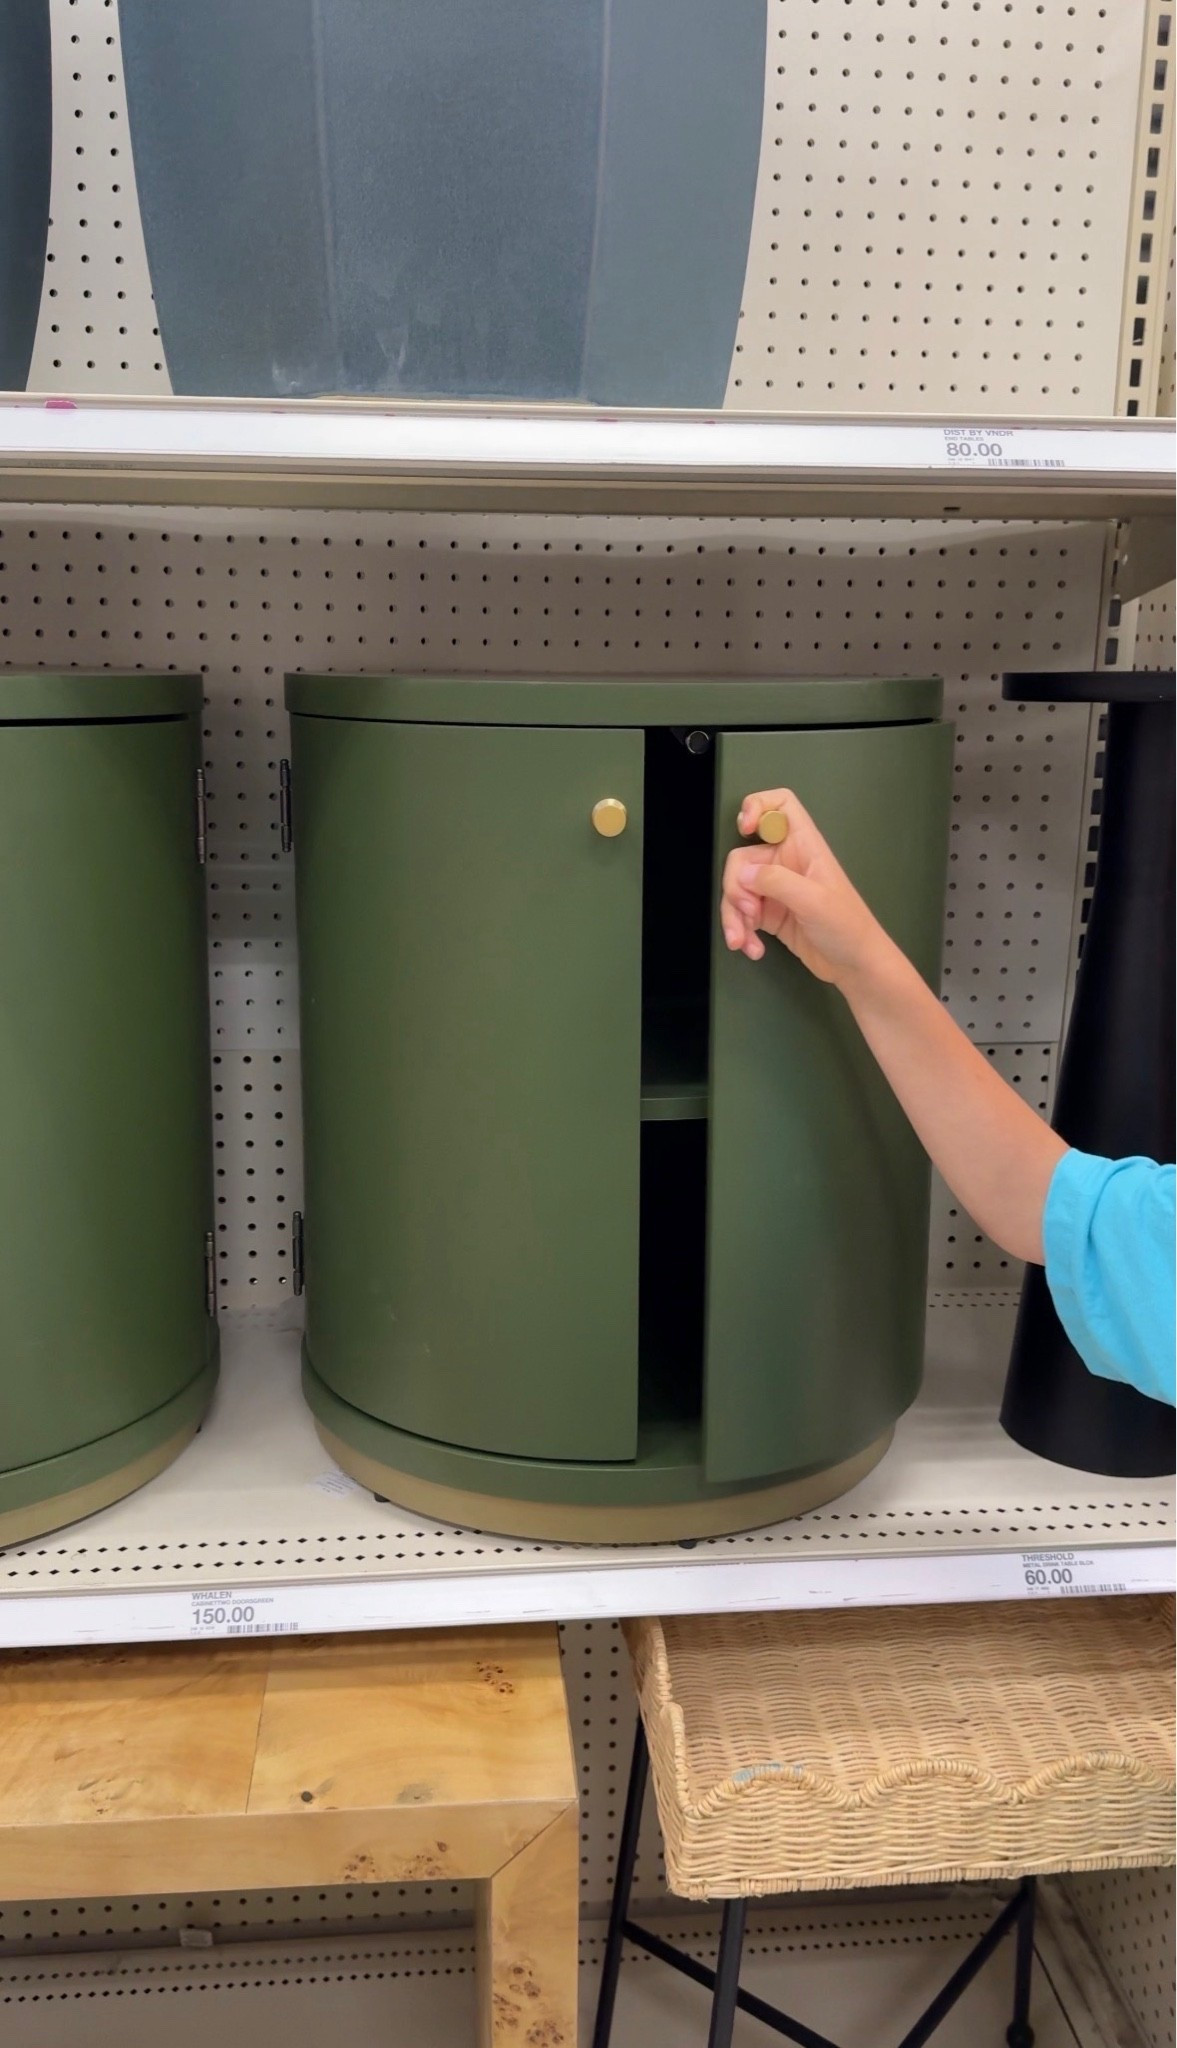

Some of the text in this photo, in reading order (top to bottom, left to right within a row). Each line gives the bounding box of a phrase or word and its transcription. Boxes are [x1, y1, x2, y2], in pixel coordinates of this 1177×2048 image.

[946, 442, 1003, 457] 80.00
[1021, 1552, 1074, 1562] THRESHOLD
[1024, 1567, 1073, 1586] 60.00
[191, 1591, 233, 1600] WHALEN
[192, 1605, 255, 1625] 150.00
